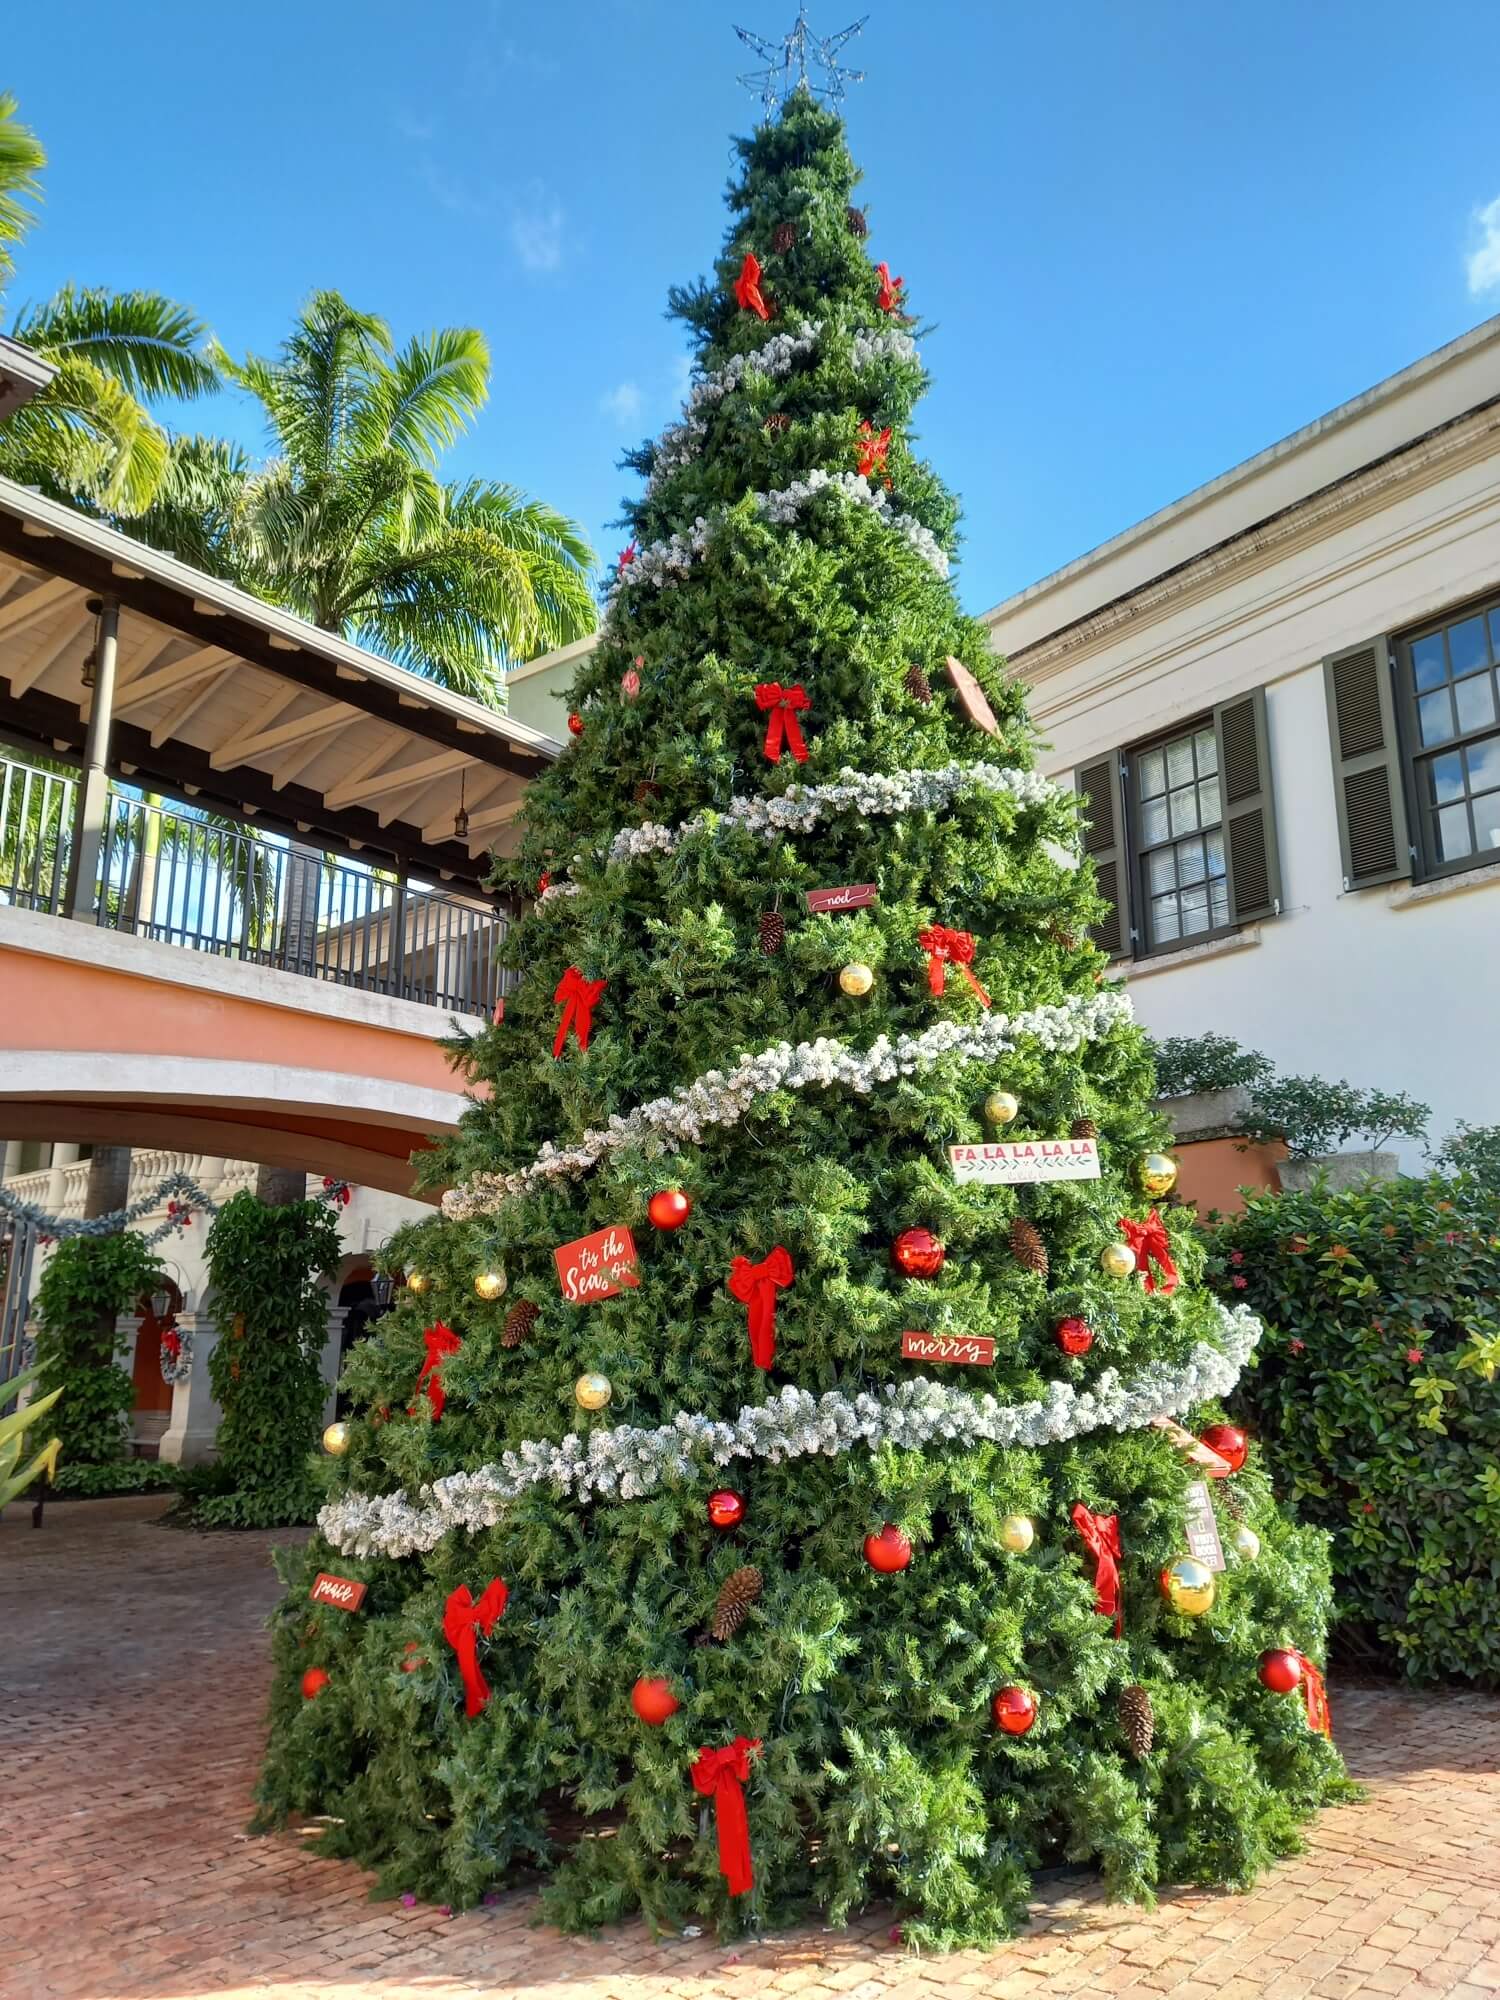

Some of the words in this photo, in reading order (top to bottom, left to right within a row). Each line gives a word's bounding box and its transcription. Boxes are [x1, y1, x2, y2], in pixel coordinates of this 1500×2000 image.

[954, 1148, 977, 1161] FA
[983, 1146, 1006, 1159] LA
[1013, 1145, 1035, 1157] LA
[1041, 1143, 1064, 1156] LA
[1070, 1142, 1093, 1155] LA
[601, 1231, 624, 1262] the
[908, 1338, 988, 1362] merry
[313, 1580, 353, 1602] peace
